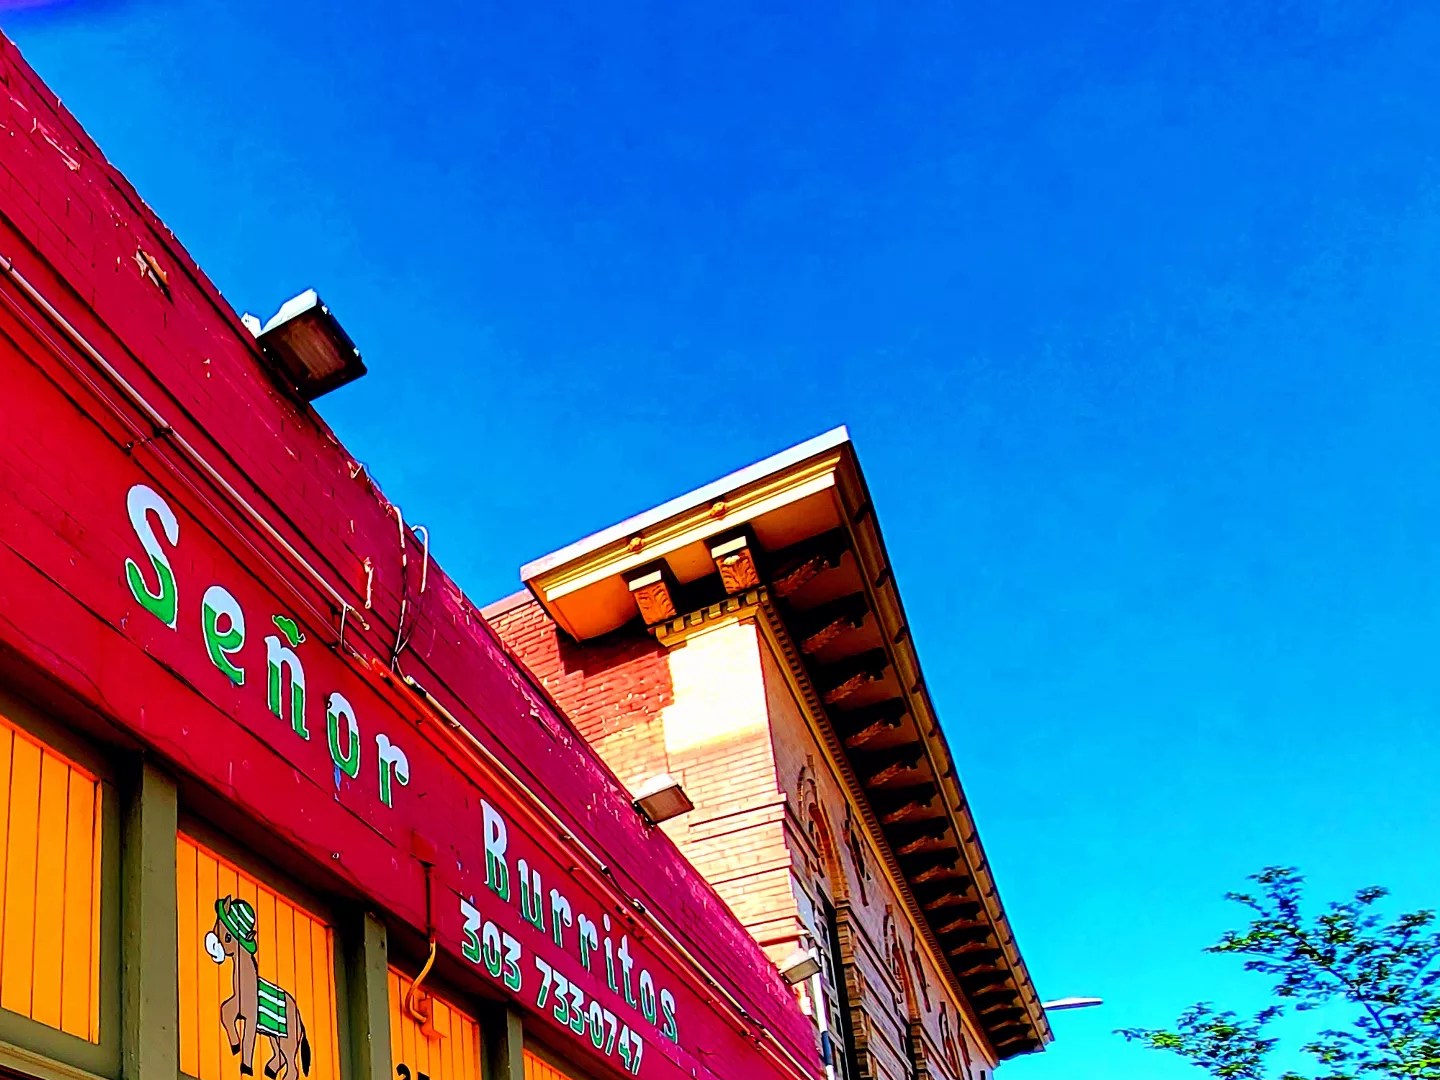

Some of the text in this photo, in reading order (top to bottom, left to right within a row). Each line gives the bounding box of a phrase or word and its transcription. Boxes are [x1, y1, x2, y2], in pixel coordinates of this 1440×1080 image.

[460, 899, 643, 1076] 303 733-0747
[480, 799, 679, 1044] Burritos
